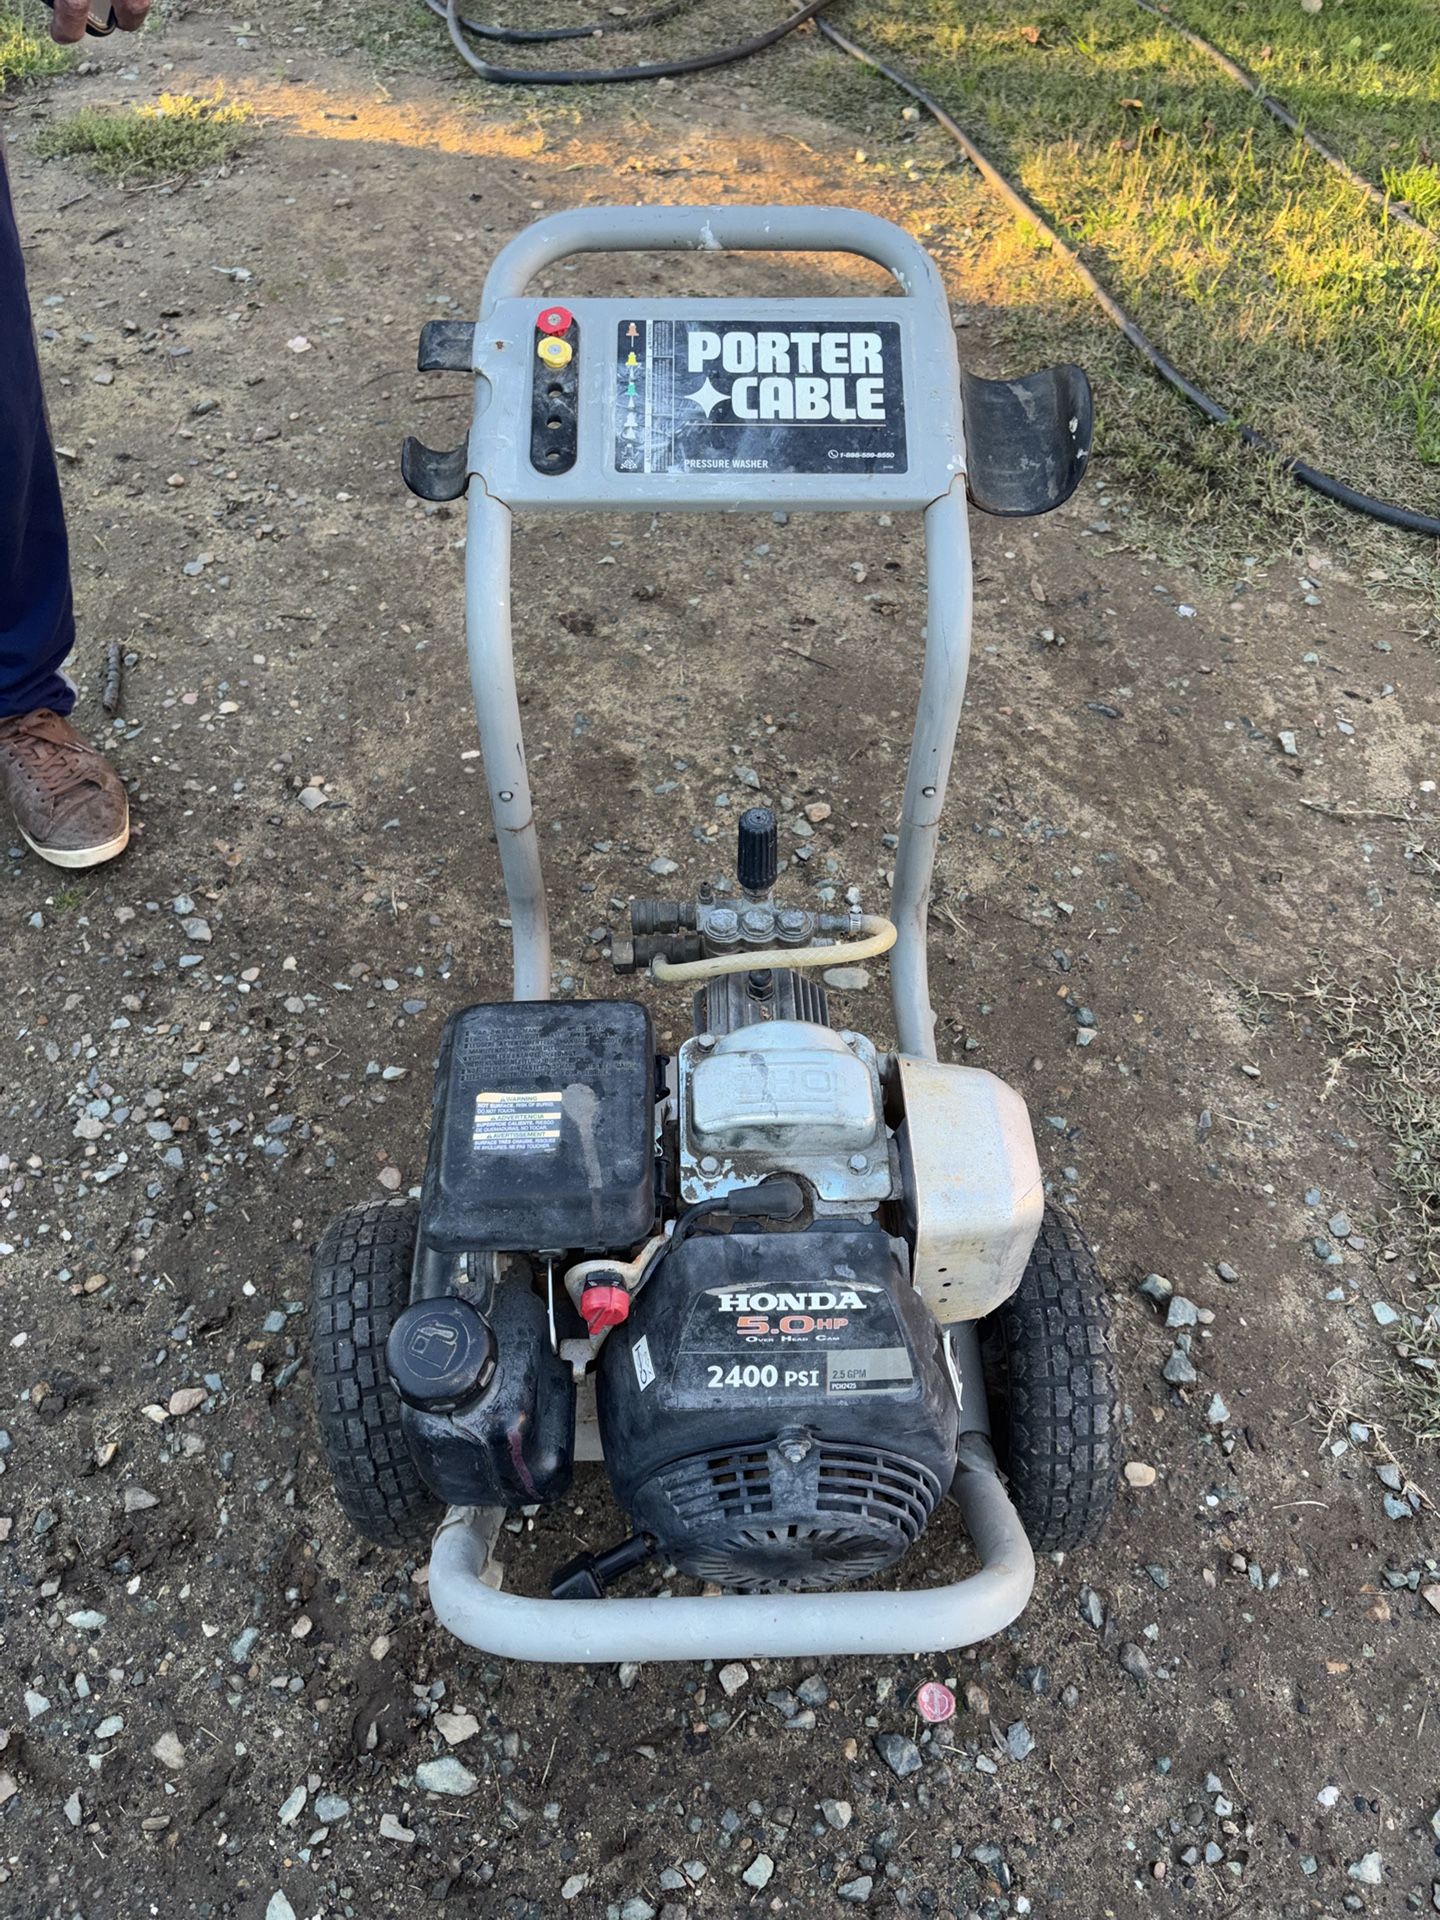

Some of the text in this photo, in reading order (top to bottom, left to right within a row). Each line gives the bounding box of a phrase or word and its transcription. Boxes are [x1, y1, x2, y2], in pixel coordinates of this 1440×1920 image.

[688, 331, 884, 374] PORTER
[731, 376, 886, 420] CABLE
[684, 458, 769, 469] PRESSURE WASHER
[718, 1291, 867, 1312] HONDA
[707, 1364, 820, 1388] 2400 PSI
[832, 1369, 867, 1379] 2.5 GPM
